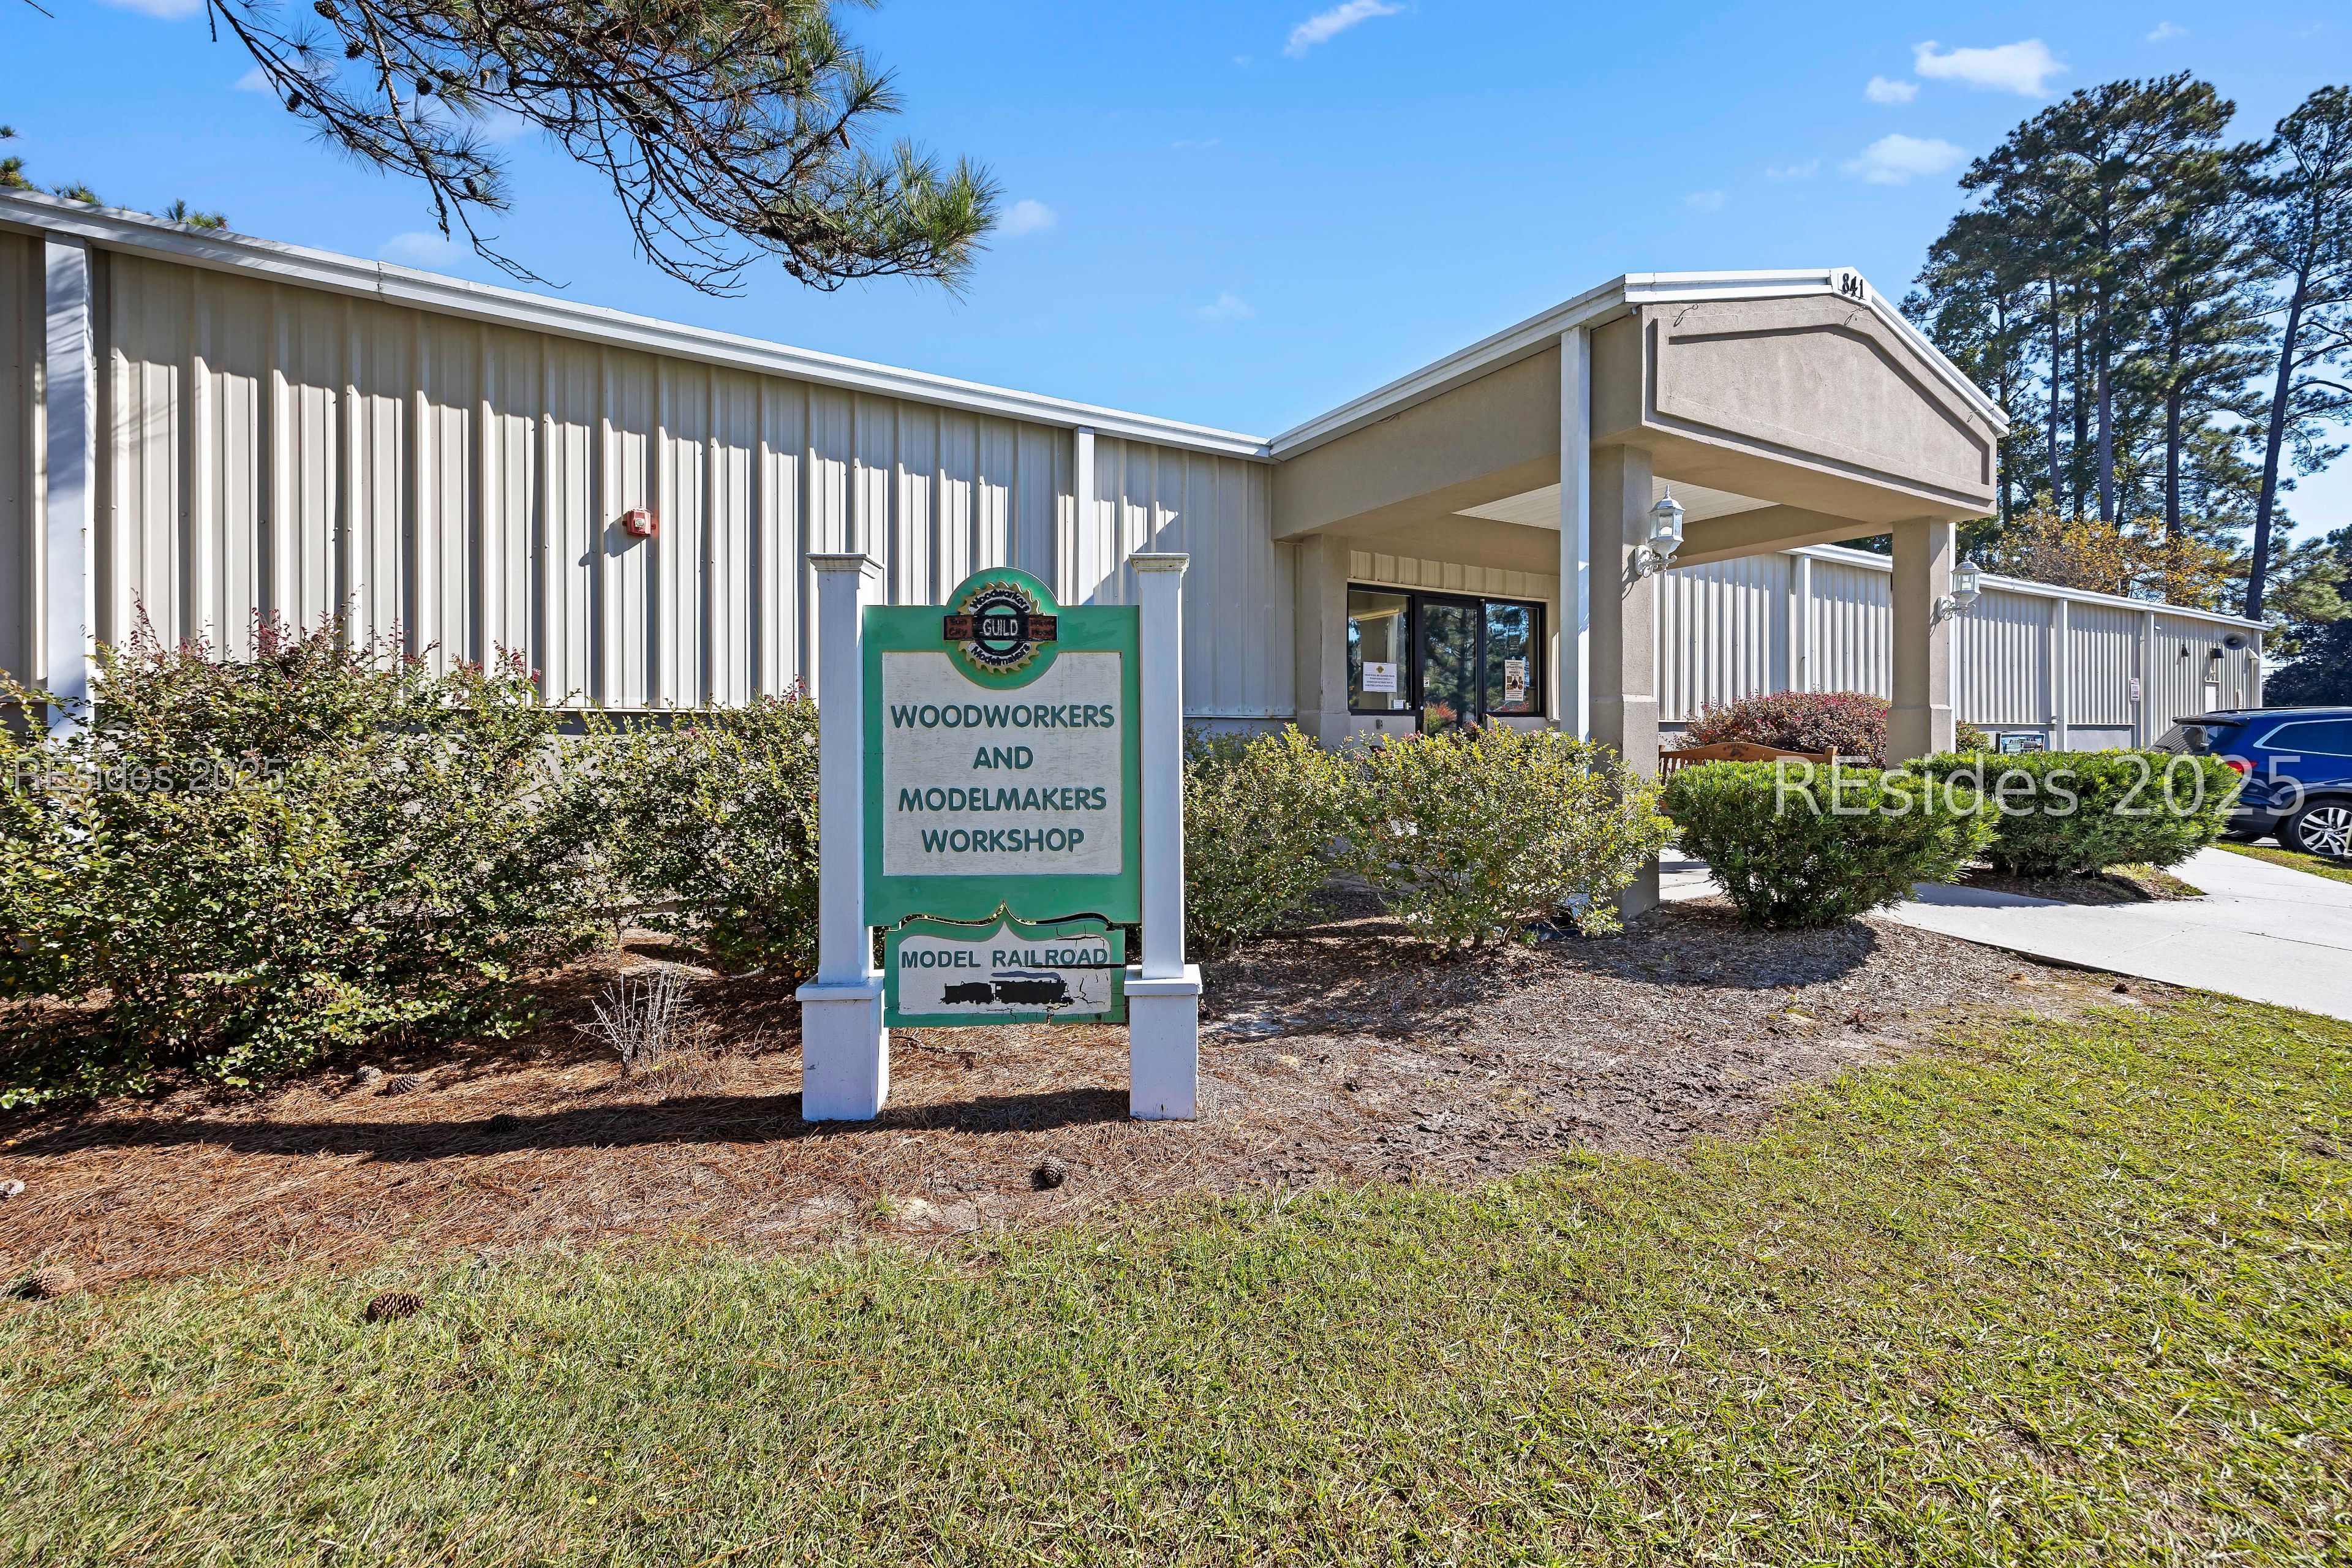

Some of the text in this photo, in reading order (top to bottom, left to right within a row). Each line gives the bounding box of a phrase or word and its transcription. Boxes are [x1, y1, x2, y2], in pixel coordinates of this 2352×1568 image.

[1842, 273, 1864, 300] 841
[983, 618, 1018, 636] GUILD
[891, 704, 1115, 728] WOODWORKERS
[973, 746, 1034, 770] AND
[899, 787, 1107, 812] MODELMAKERS
[921, 828, 1084, 853] WORKSHOP
[902, 949, 1108, 968] MODEL RAILROAD
